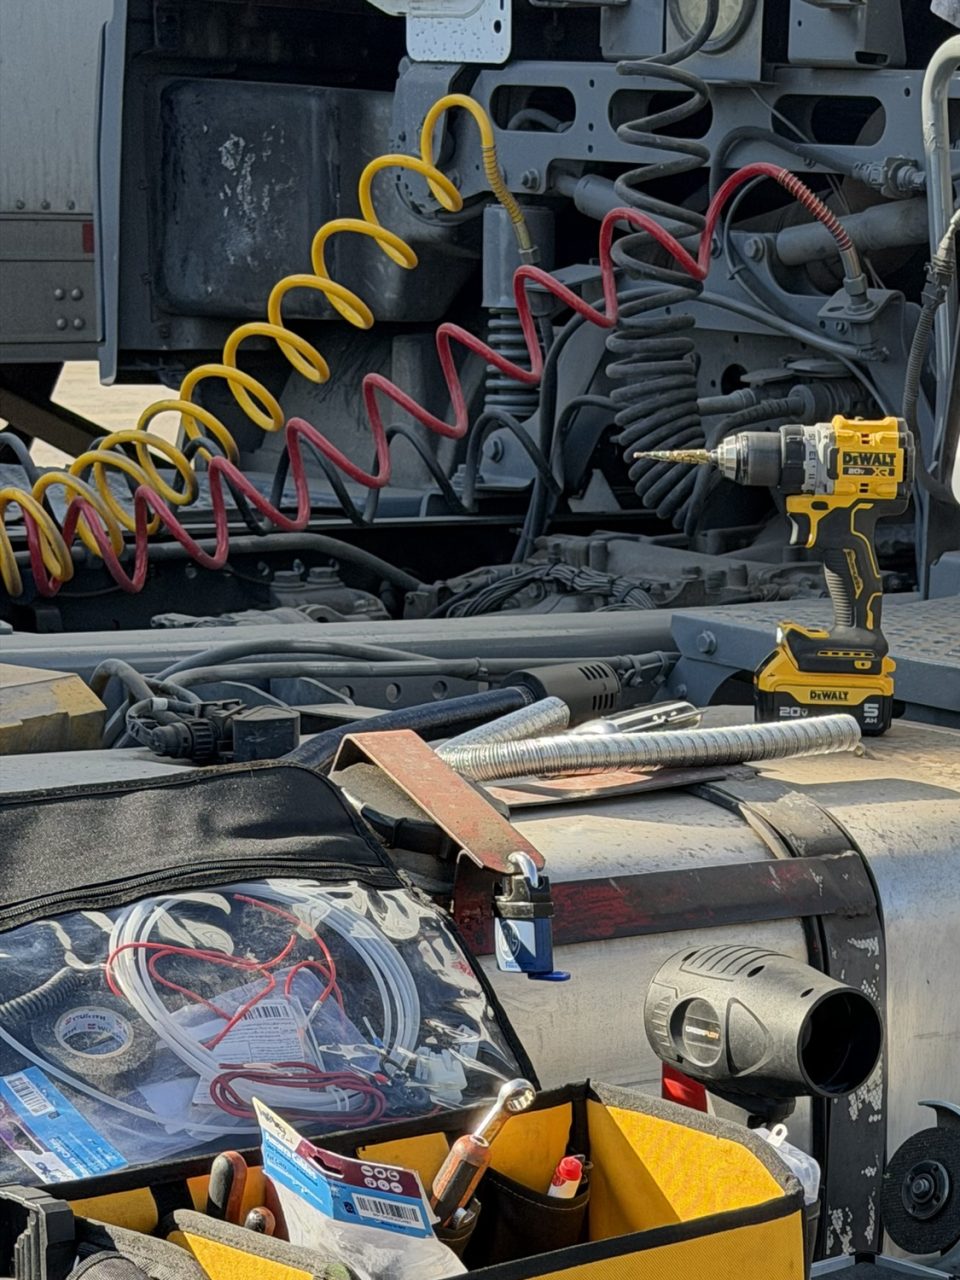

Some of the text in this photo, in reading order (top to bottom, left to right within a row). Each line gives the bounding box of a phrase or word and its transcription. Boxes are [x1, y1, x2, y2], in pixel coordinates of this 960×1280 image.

[843, 452, 896, 466] DEWALT
[809, 690, 849, 701] DEWALT
[779, 706, 809, 717] 20V
[863, 703, 879, 717] 5
